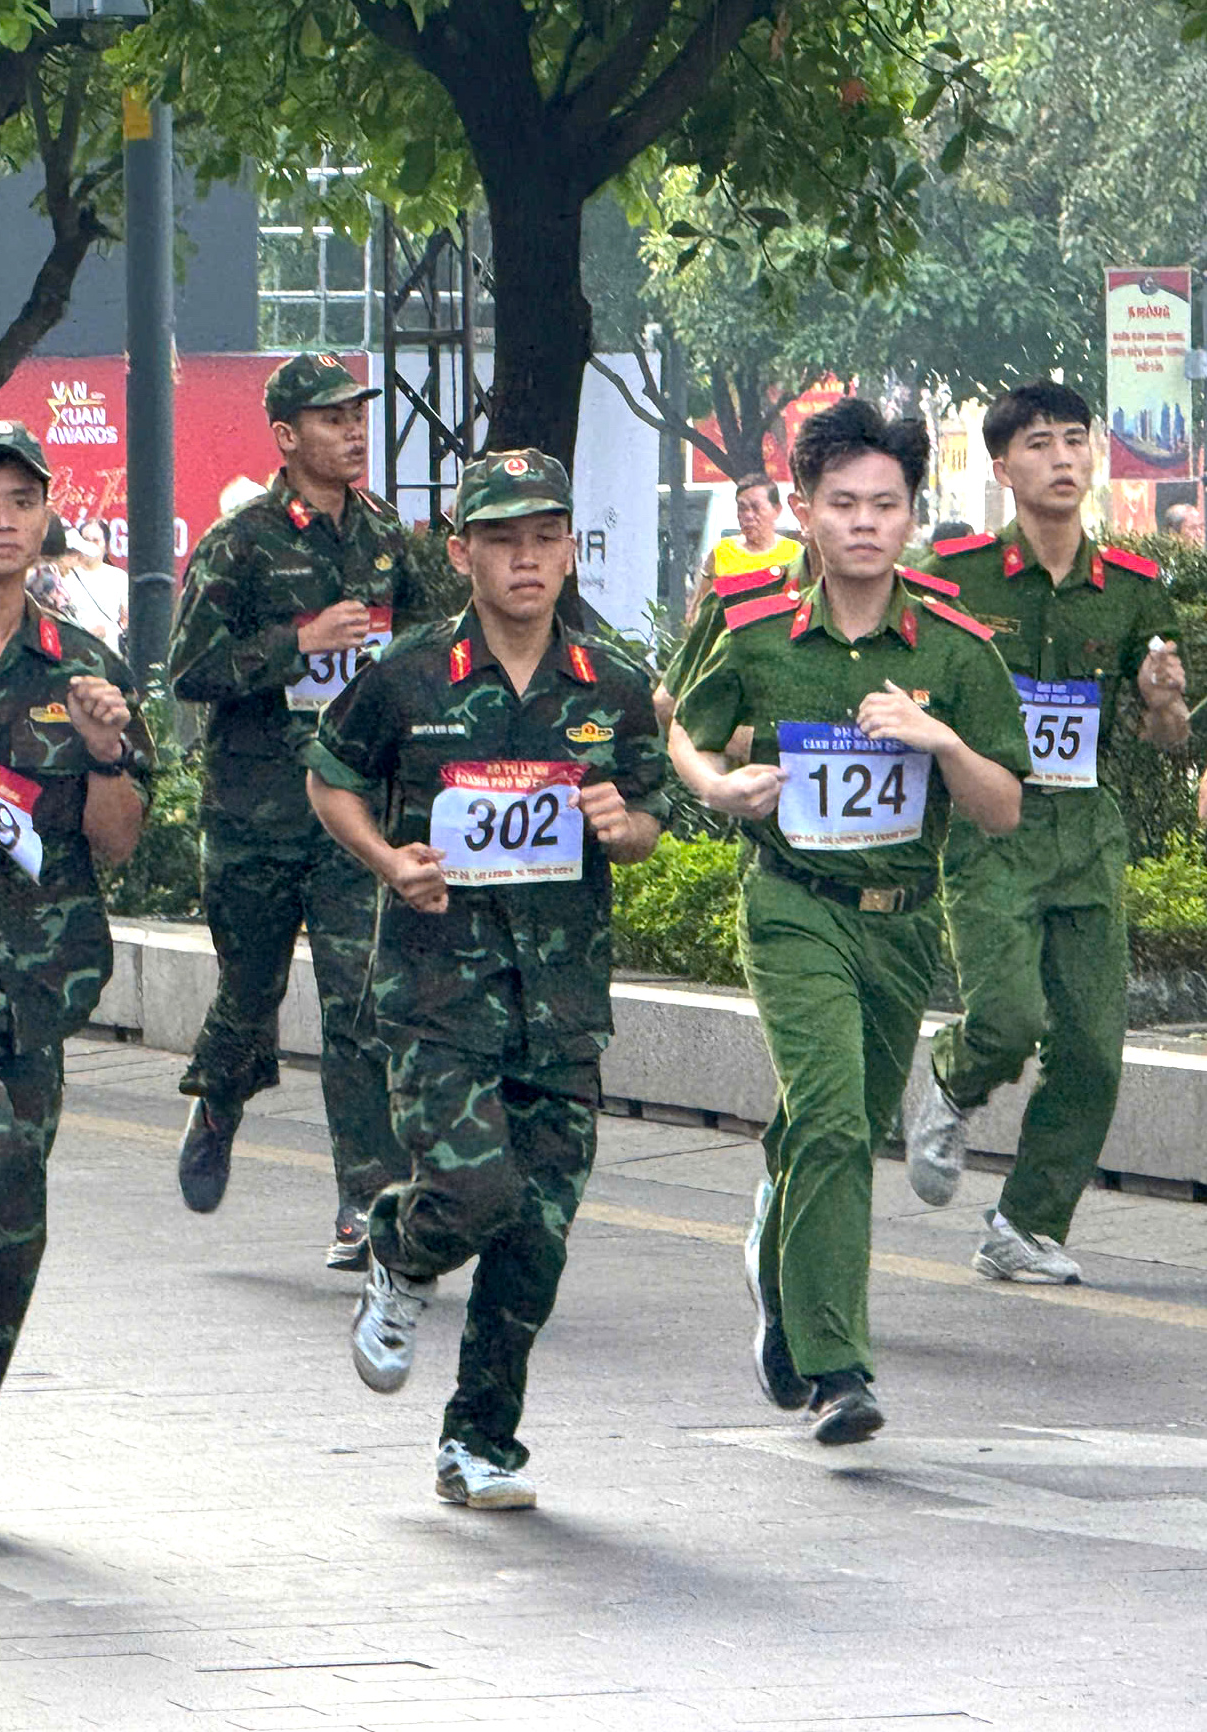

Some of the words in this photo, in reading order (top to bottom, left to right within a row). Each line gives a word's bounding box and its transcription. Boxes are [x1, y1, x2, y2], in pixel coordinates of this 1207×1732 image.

[1022, 712, 1083, 760] 55
[807, 763, 907, 818] 124
[464, 792, 560, 852] 302
